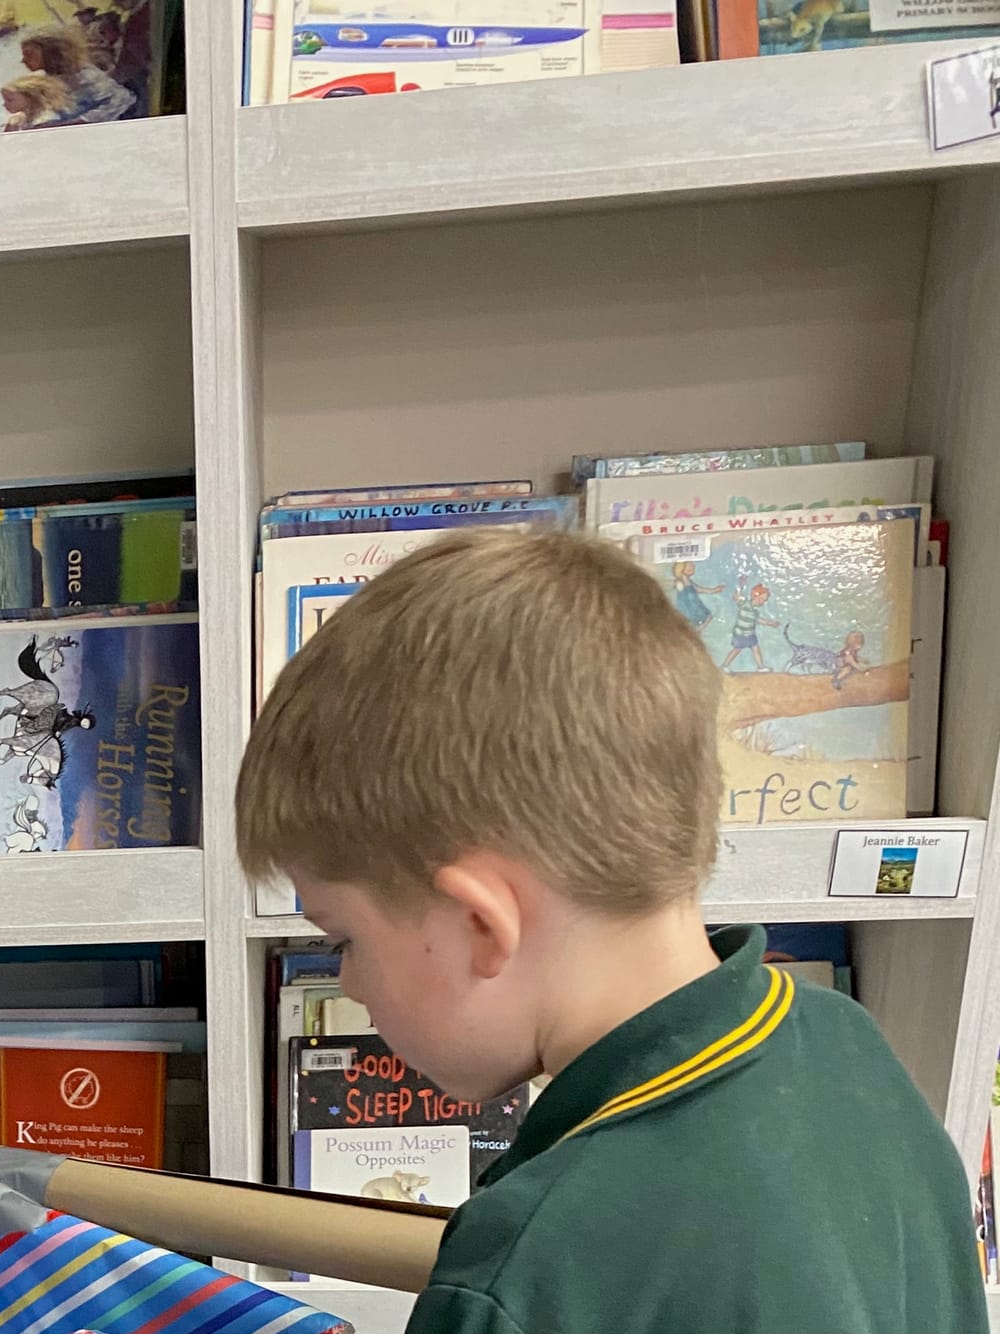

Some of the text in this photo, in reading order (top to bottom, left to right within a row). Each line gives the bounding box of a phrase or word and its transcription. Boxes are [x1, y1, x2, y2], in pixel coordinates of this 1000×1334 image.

[339, 505, 420, 519] WILLOW
[432, 501, 491, 515] GROVE
[642, 514, 835, 535] BRUCE WHATLEY
[67, 549, 83, 593] one
[114, 717, 132, 740] the
[128, 682, 190, 841] Running
[729, 772, 859, 824] rfect
[863, 836, 941, 847] Jeannie Baker
[345, 1087, 413, 1125] SLEEP
[16, 1121, 47, 1144] King
[49, 1123, 62, 1132] Pig
[80, 1124, 102, 1132] make
[104, 1125, 117, 1134] the
[119, 1125, 143, 1135] sheep
[37, 1136, 47, 1144] do
[49, 1137, 85, 1148] anything
[87, 1137, 97, 1147] he
[325, 1133, 456, 1154] Possum Magic
[472, 1140, 511, 1150] Horacek
[106, 1153, 121, 1162] like
[124, 1154, 145, 1163] him?
[355, 1153, 426, 1169] Opposites
